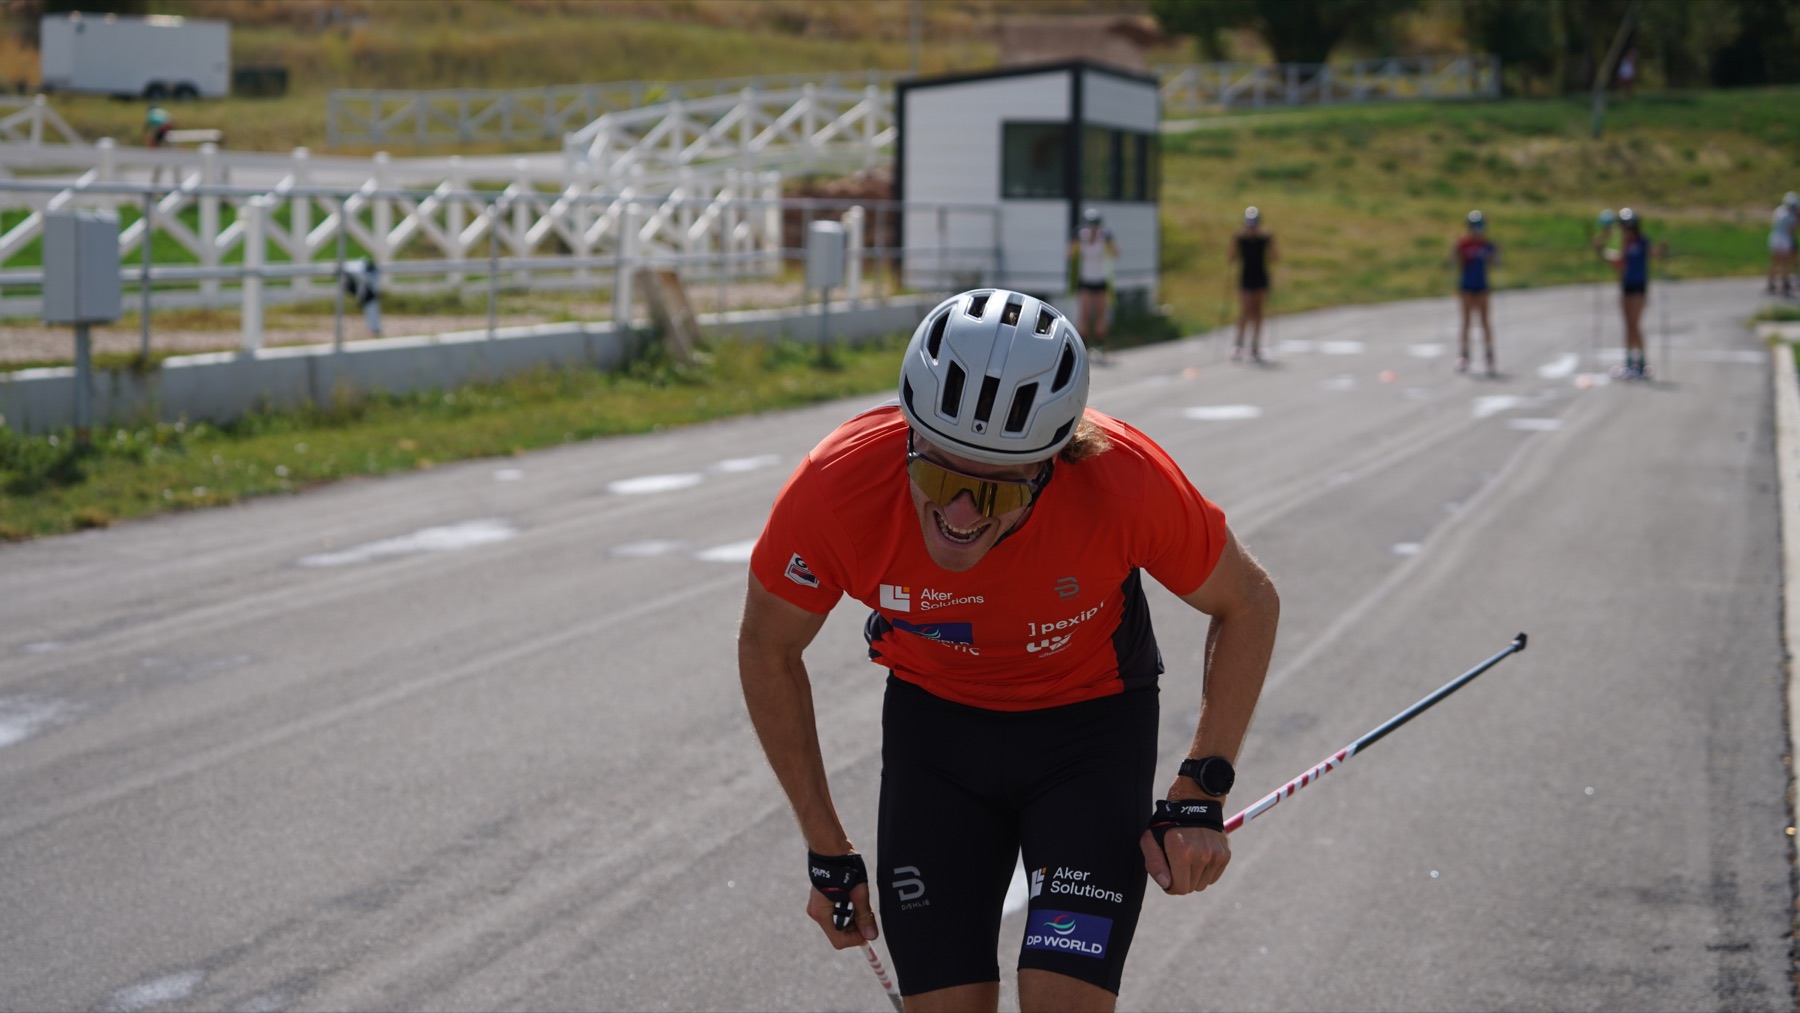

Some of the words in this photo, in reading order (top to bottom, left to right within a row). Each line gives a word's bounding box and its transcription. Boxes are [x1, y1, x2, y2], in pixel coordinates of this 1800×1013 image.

[920, 588, 953, 601] Aker
[920, 595, 985, 611] Solutions
[1052, 866, 1091, 882] Aker
[1050, 880, 1124, 904] Solutions
[1026, 935, 1043, 946] DP
[1043, 935, 1103, 955] WORLD
